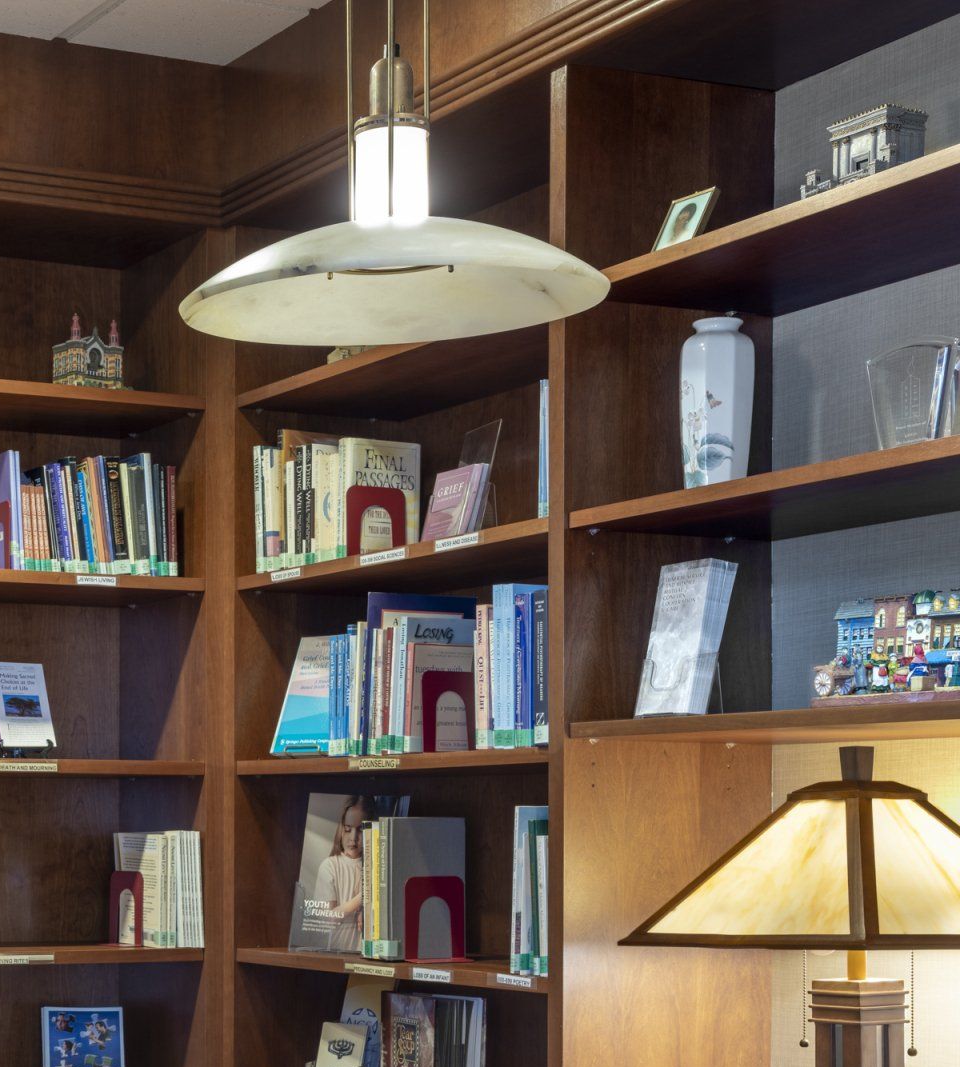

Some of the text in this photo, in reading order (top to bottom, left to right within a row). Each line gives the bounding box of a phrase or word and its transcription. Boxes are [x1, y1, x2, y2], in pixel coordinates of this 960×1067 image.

[364, 448, 407, 472] FINAL
[355, 471, 415, 491] PASSAGES
[437, 482, 465, 498] GRIEF
[414, 623, 454, 644] LOSING
[359, 759, 395, 768] COUNSELING
[304, 899, 330, 909] YOUTH
[311, 908, 345, 918] FUNERALS
[512, 977, 530, 986] POETRY
